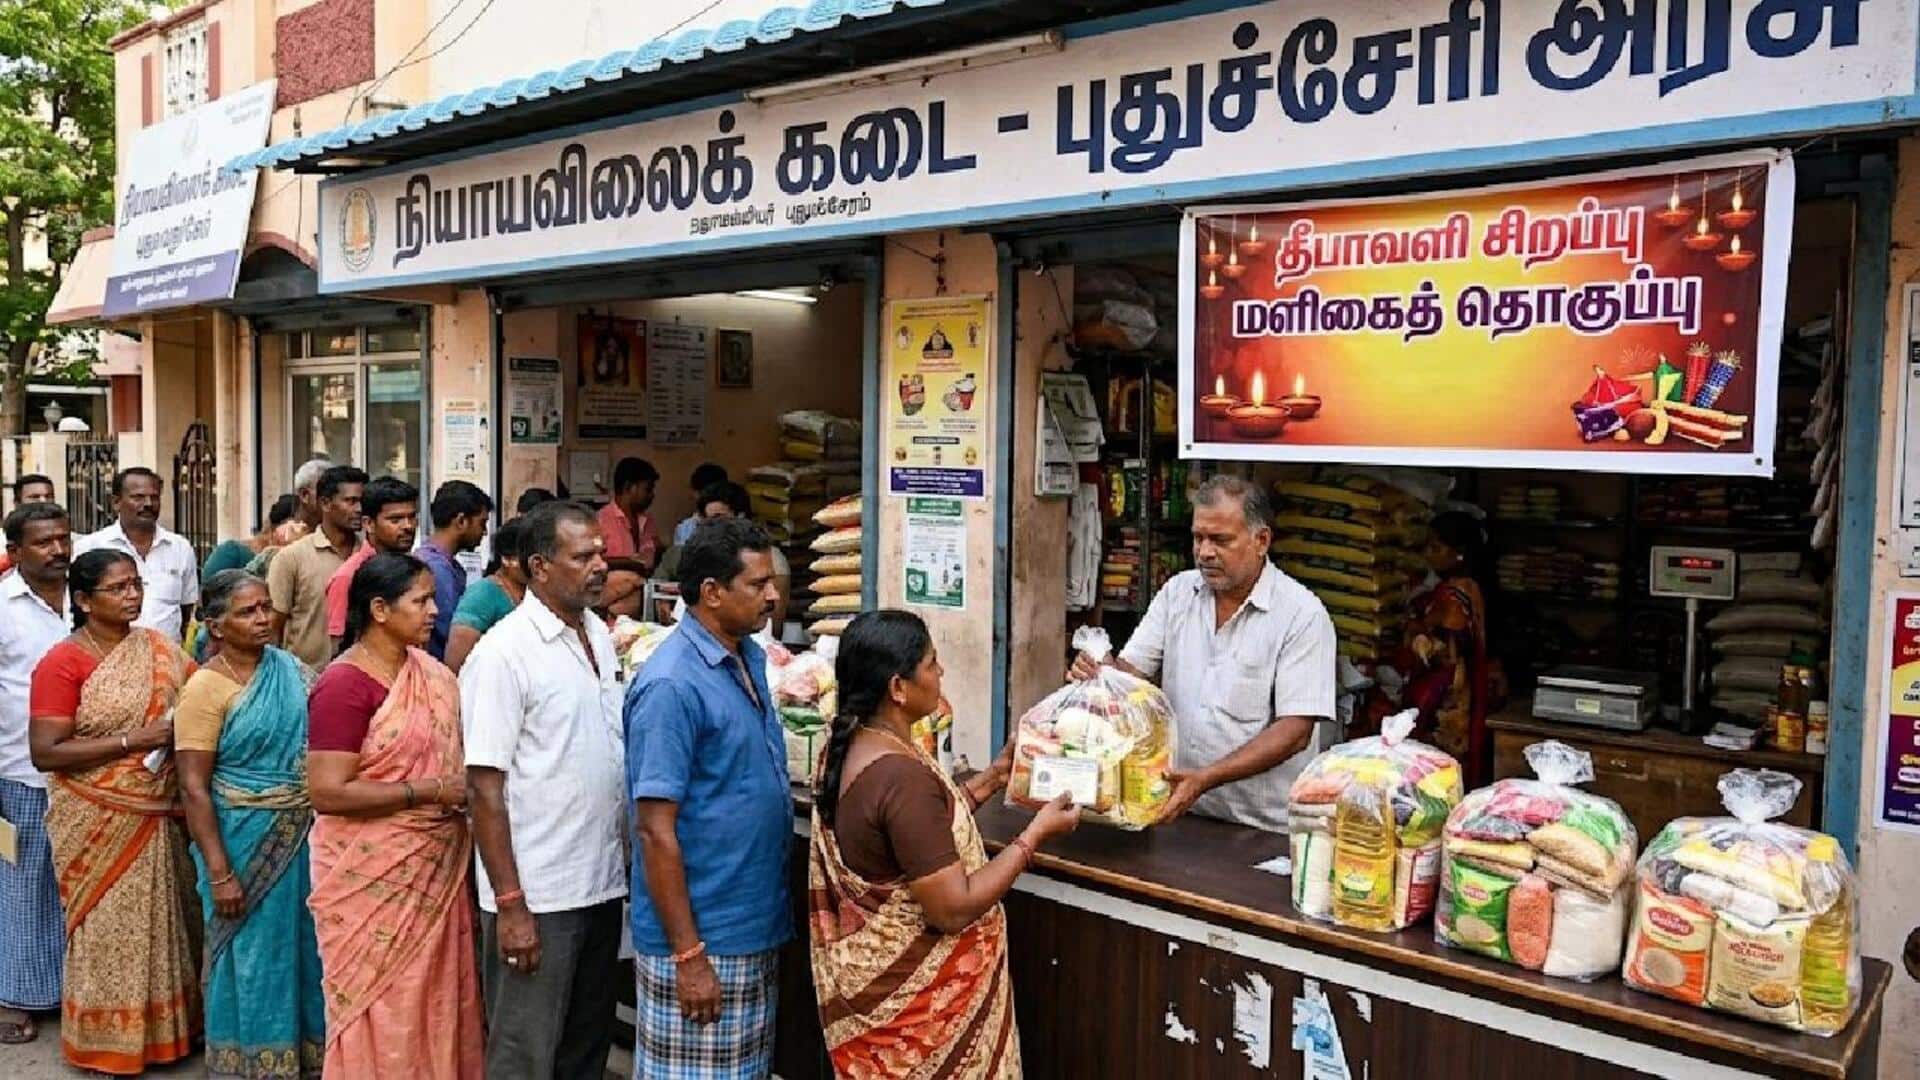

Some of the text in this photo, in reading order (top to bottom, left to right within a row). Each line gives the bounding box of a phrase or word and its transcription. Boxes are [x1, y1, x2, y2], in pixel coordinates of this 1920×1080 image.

[393, 108, 754, 268] நியாயவிலைக்
[776, 100, 976, 195] கடை
[1056, 0, 1502, 174] புதுச்சேரி
[1275, 200, 1640, 284] தீபாவளி சிறப்பு
[1235, 268, 1698, 342] மளிகைத் தொகுப்பு
